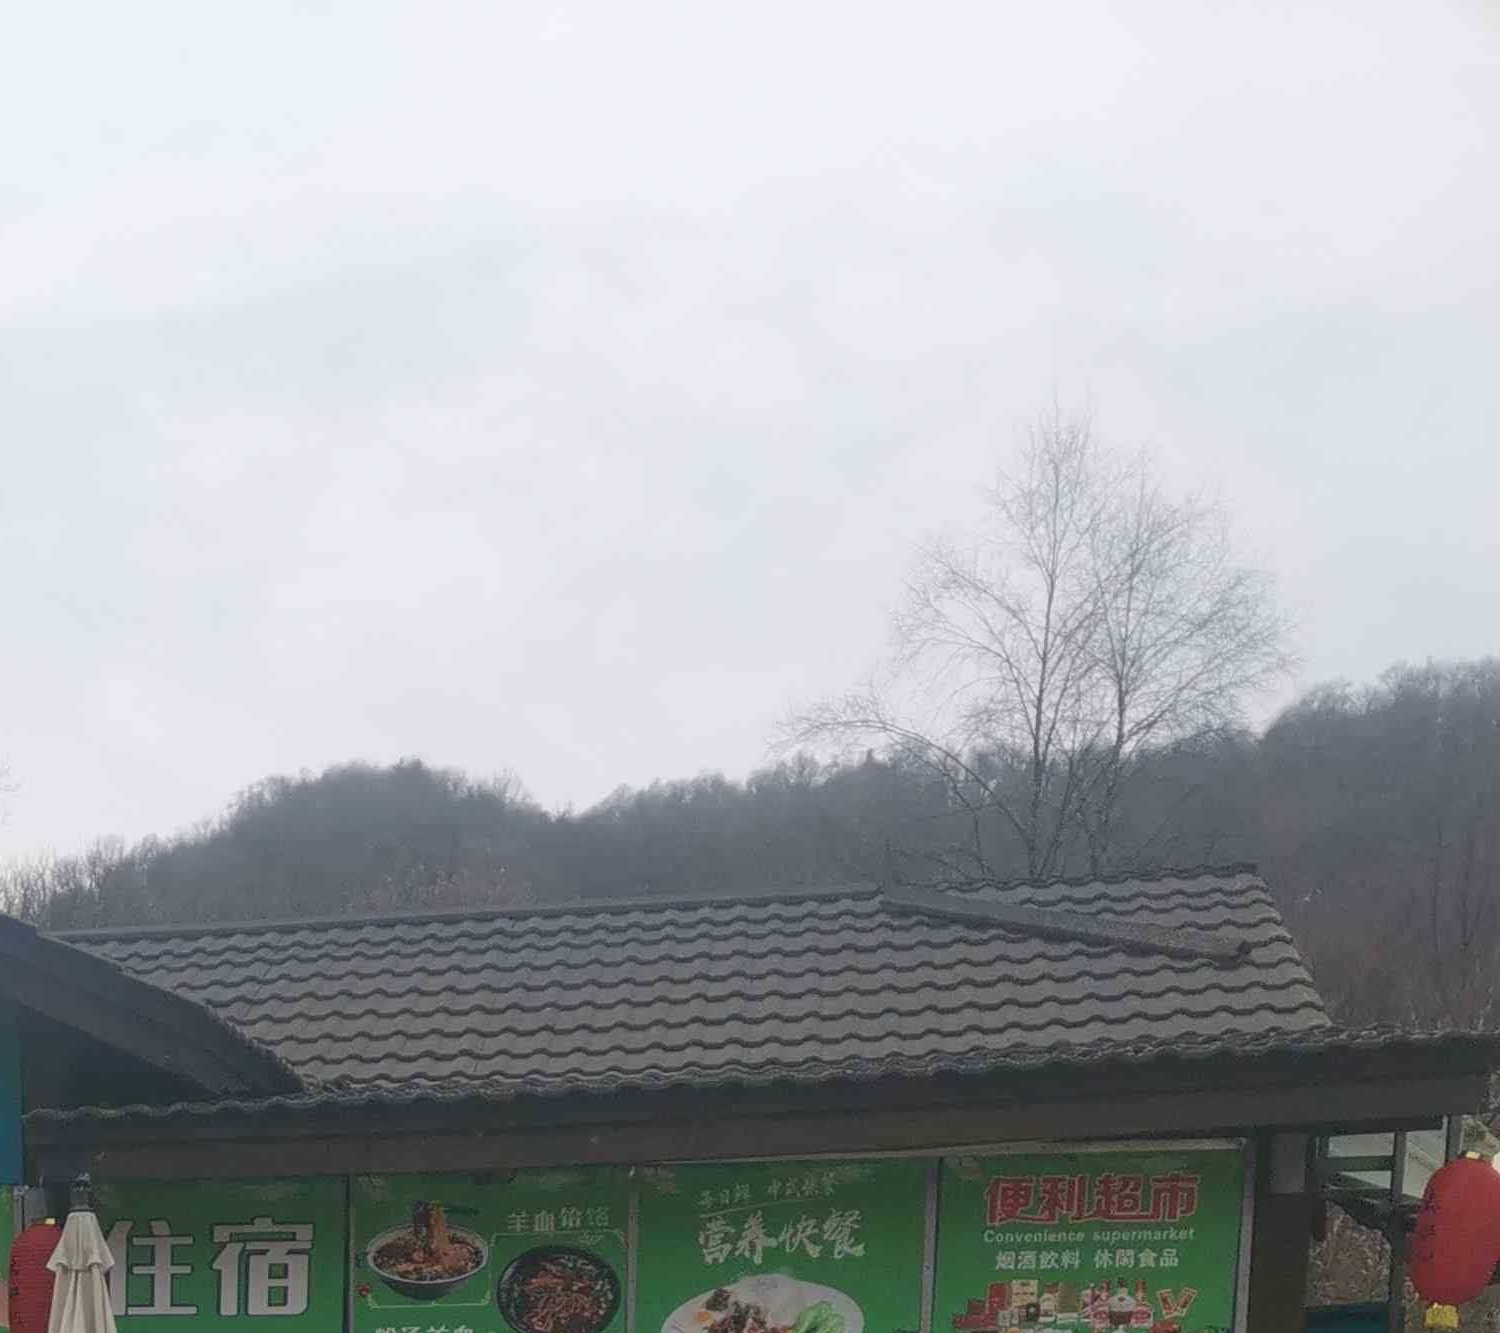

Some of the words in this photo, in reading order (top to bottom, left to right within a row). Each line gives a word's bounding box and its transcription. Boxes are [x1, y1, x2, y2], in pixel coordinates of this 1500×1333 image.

[985, 1172, 1201, 1226] 便利超市
[983, 1229, 1085, 1243] Convenience
[1092, 1227, 1195, 1246] supermarket
[107, 1216, 315, 1318] 住宿
